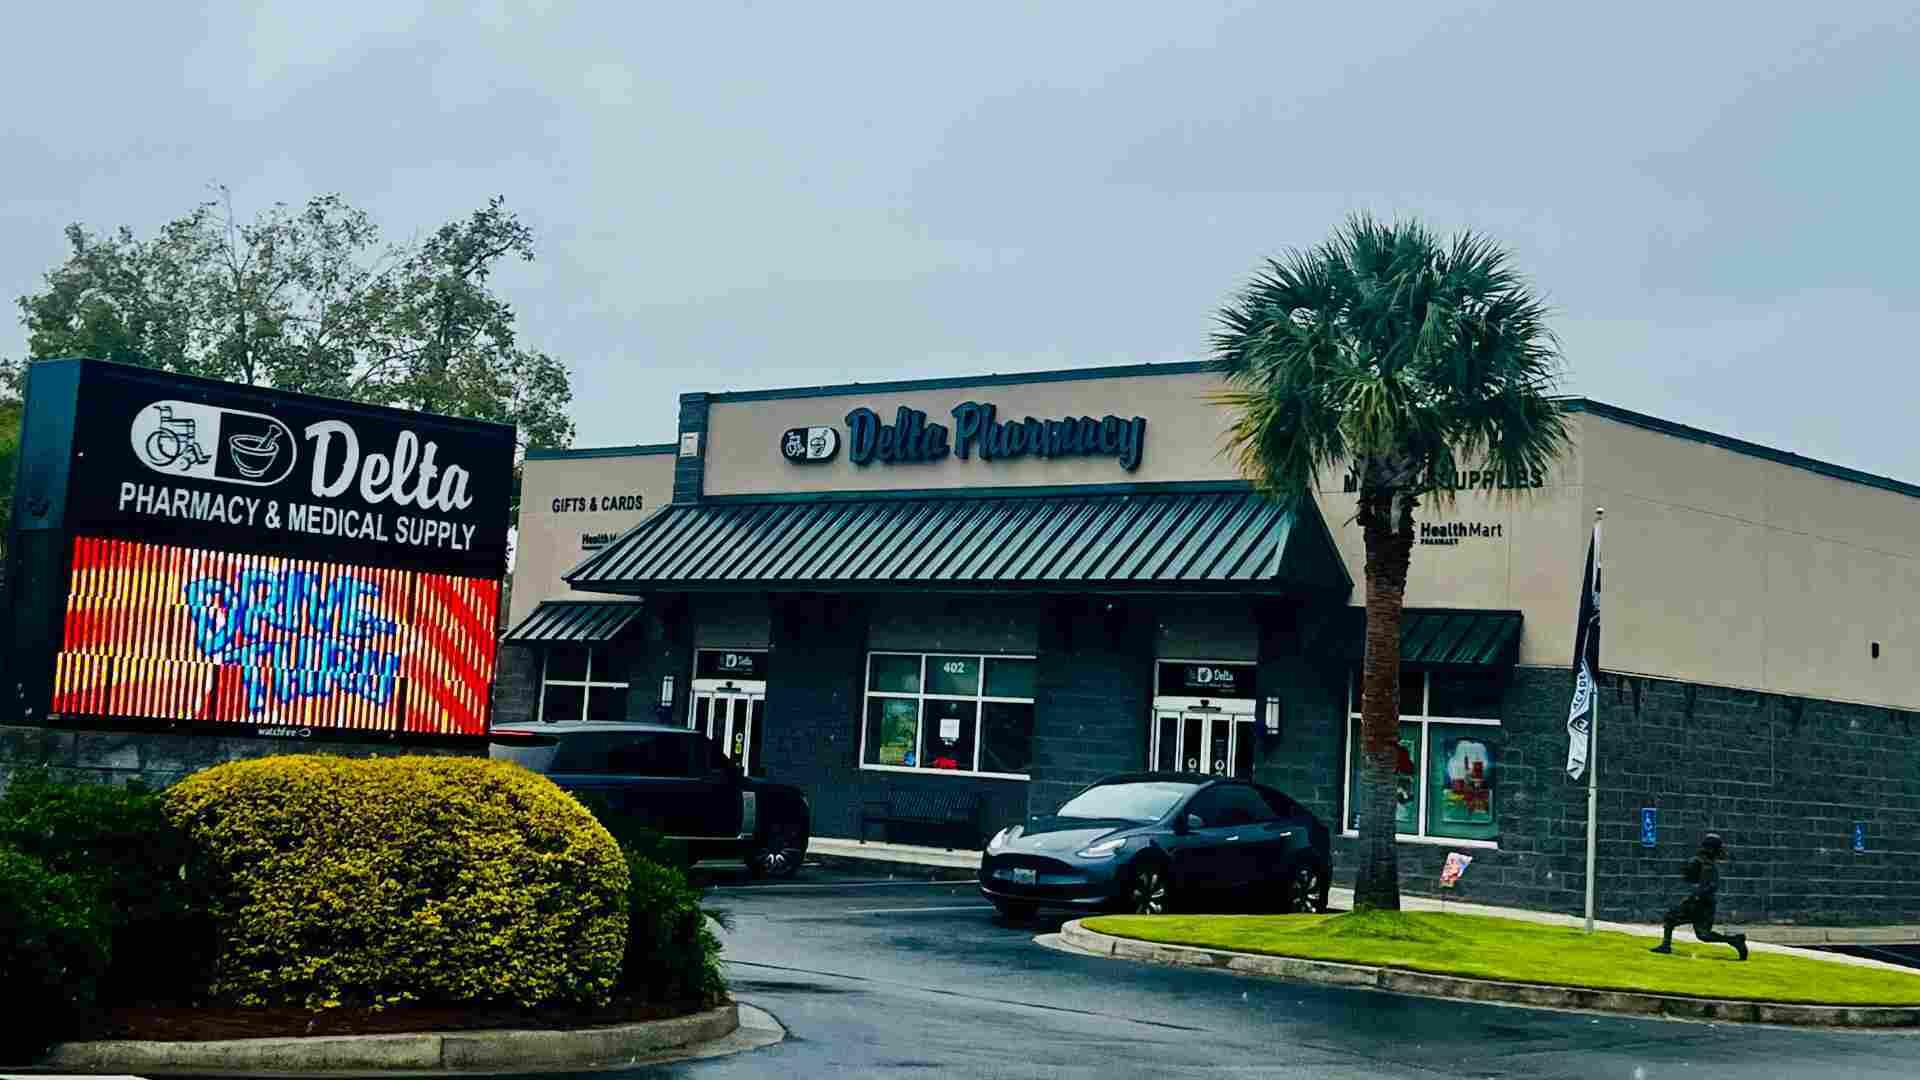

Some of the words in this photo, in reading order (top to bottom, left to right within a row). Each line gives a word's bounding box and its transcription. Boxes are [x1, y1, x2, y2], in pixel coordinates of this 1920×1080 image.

[845, 406, 950, 466] Delta
[951, 401, 1146, 473] Pharmacy
[304, 419, 473, 513] Delta
[1434, 470, 1544, 490] UPPLIES
[119, 482, 261, 527] PHARMACY
[264, 501, 282, 529] &
[288, 503, 389, 542] MEDICAL
[395, 516, 476, 551] SUPPLY
[552, 497, 586, 513] GIFTS
[589, 496, 598, 512] &
[601, 495, 643, 511] CARDS
[943, 661, 965, 674] 402
